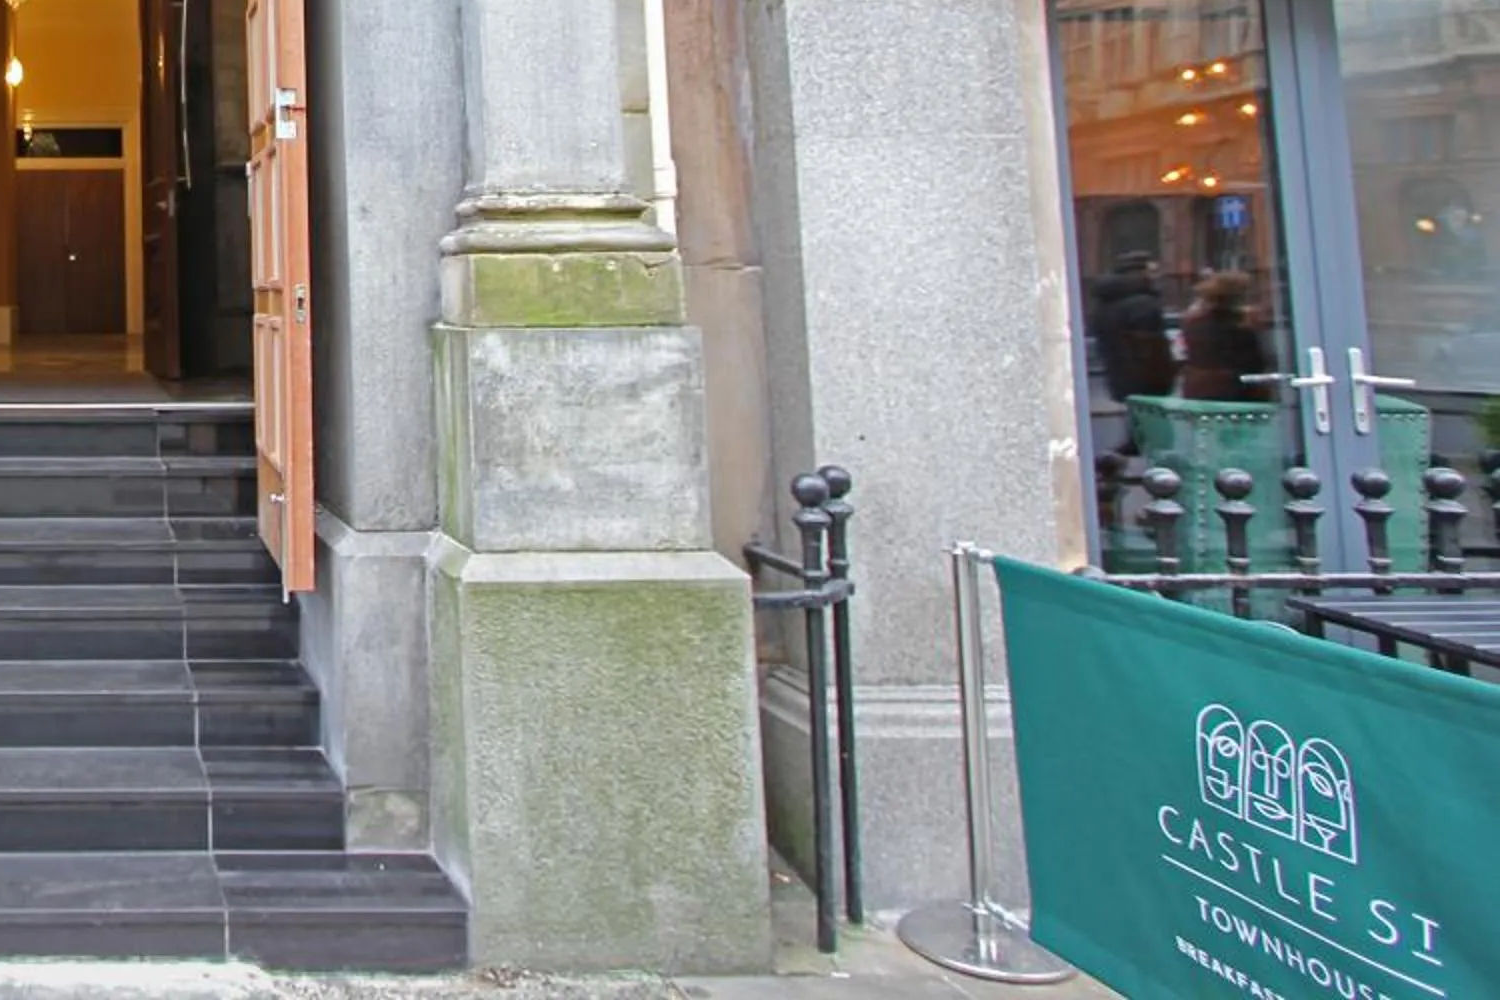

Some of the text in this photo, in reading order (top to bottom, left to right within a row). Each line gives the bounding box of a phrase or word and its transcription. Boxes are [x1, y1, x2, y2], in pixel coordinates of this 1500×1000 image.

[1157, 804, 1443, 966] CASTLE ST
[1194, 895, 1393, 1000] TOWNHOUS
